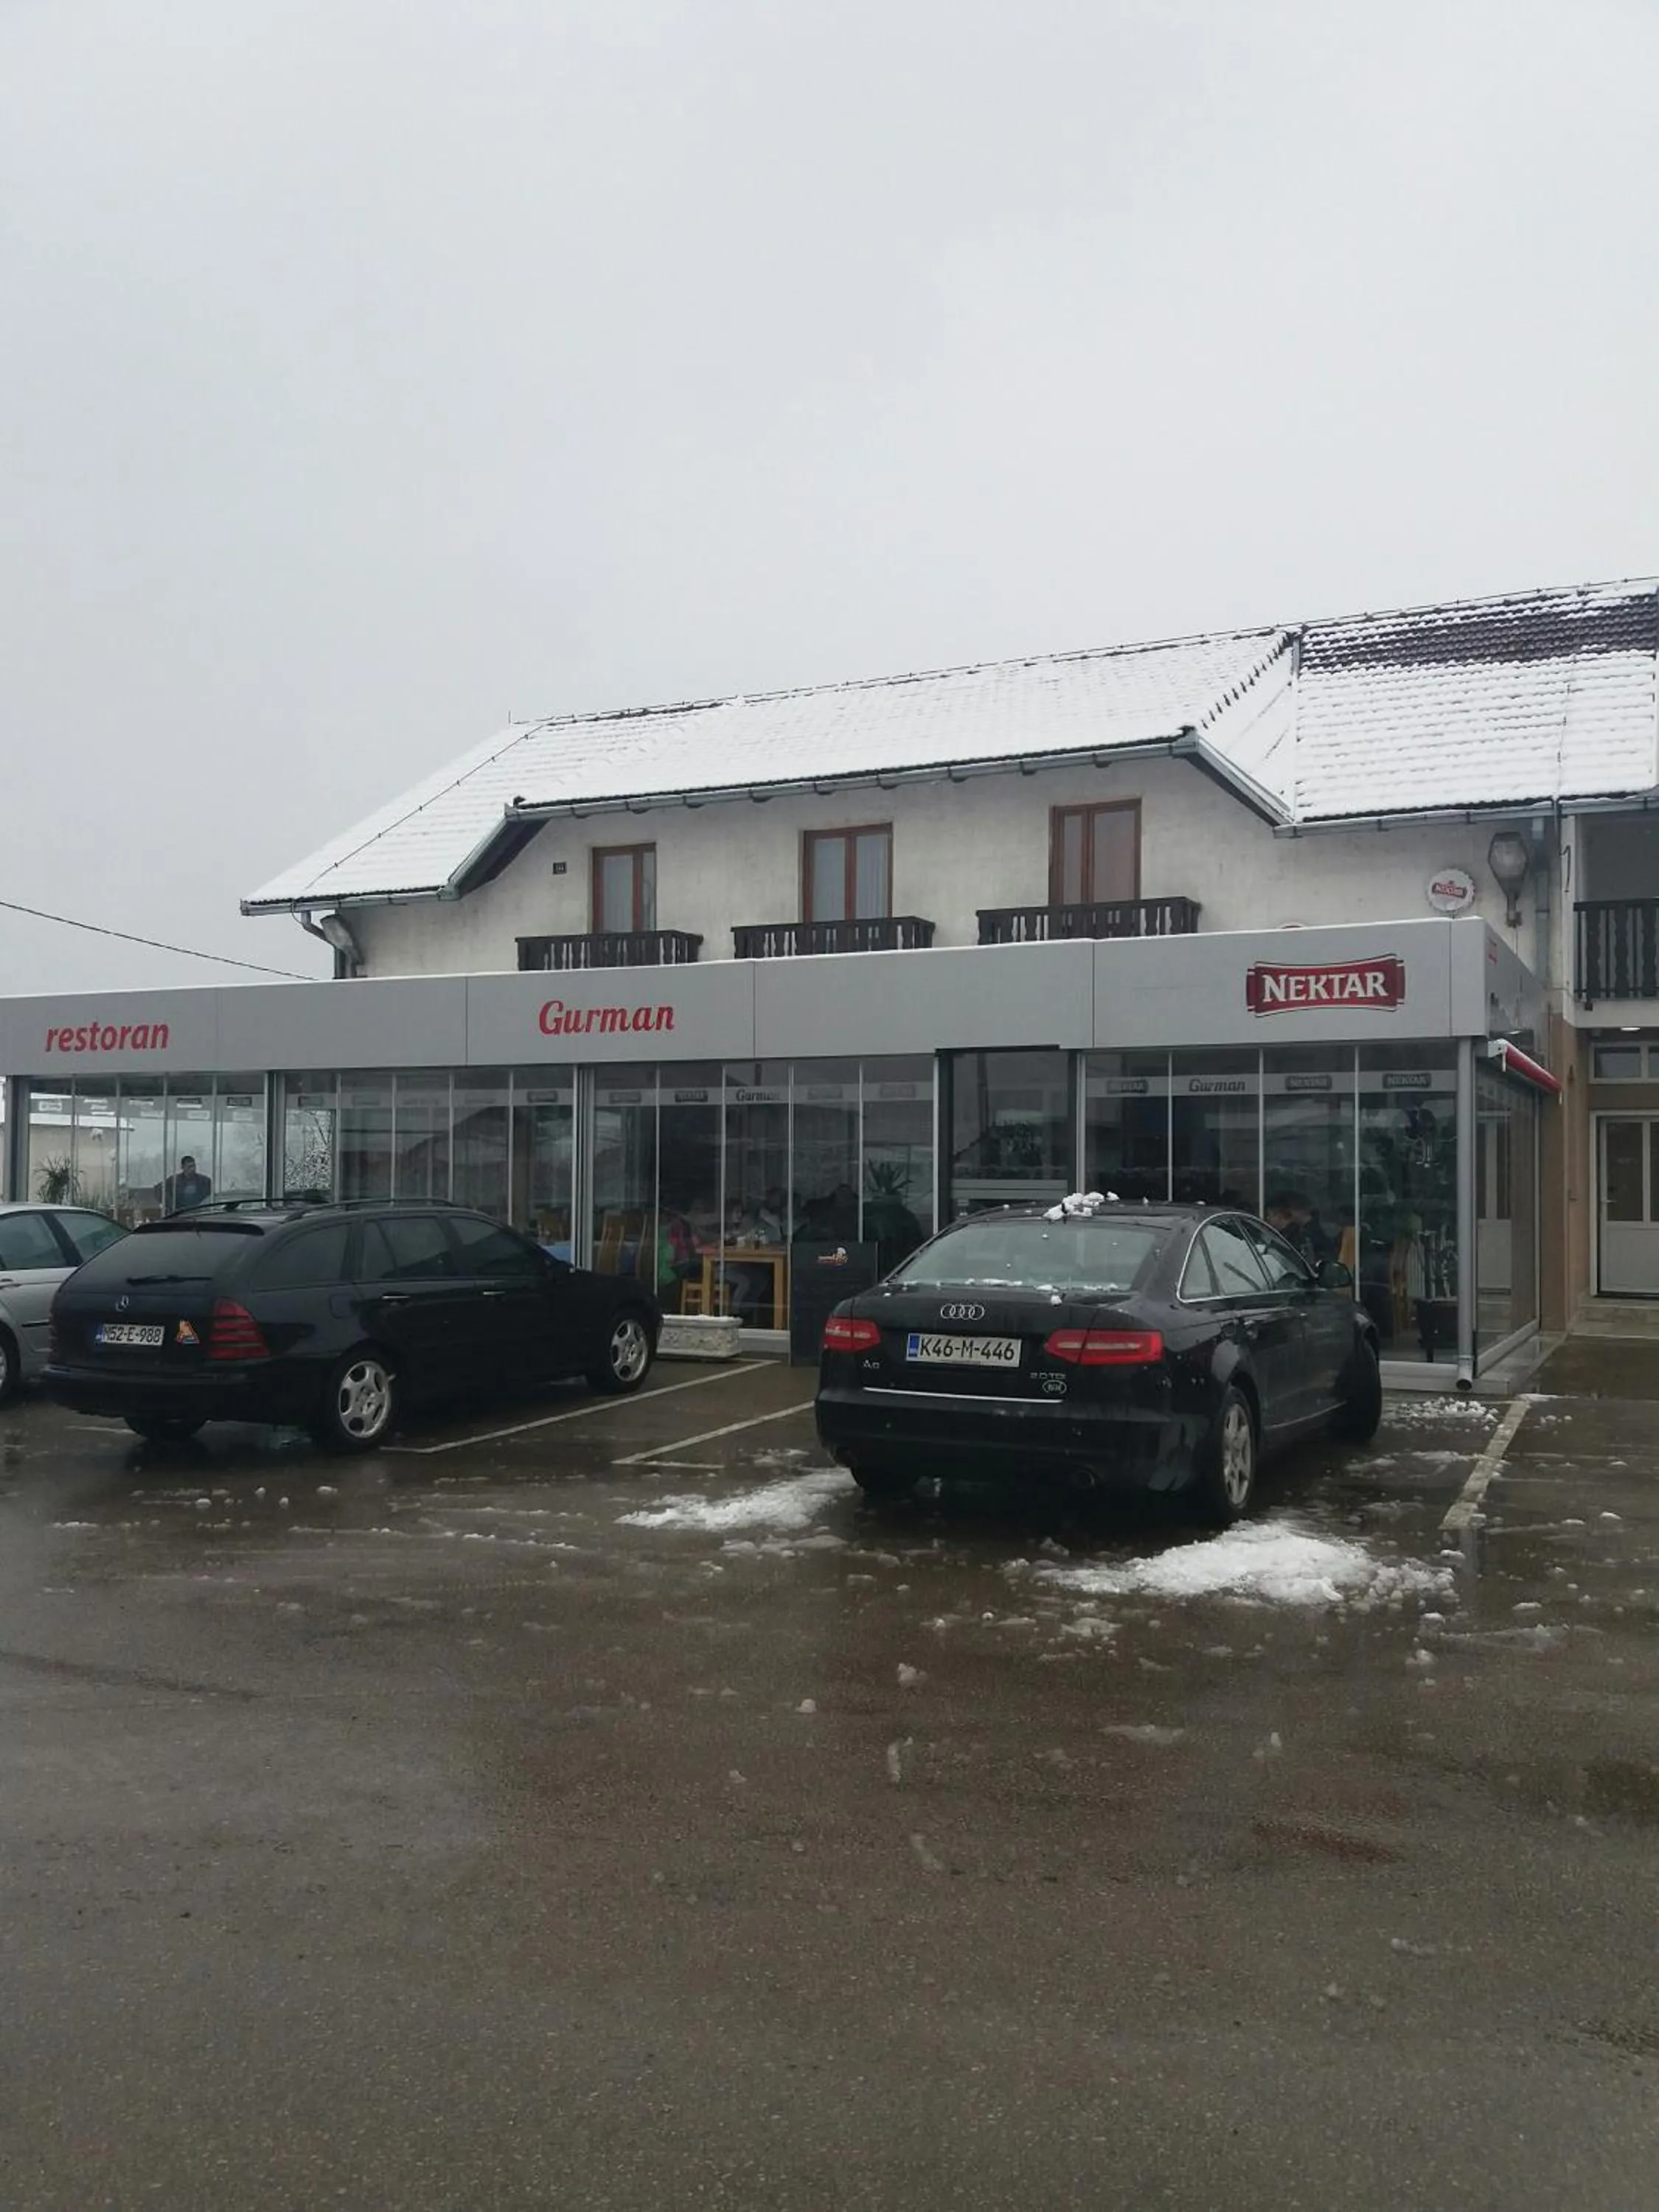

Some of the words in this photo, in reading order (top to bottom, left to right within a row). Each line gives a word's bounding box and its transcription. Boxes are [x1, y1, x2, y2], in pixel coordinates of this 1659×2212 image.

[1262, 971, 1388, 1003] NEKTAR
[539, 1000, 675, 1035] Gurman
[45, 1021, 169, 1052] restoran
[1189, 1079, 1246, 1092] Gurman
[920, 1338, 1015, 1360] K46-M-446
